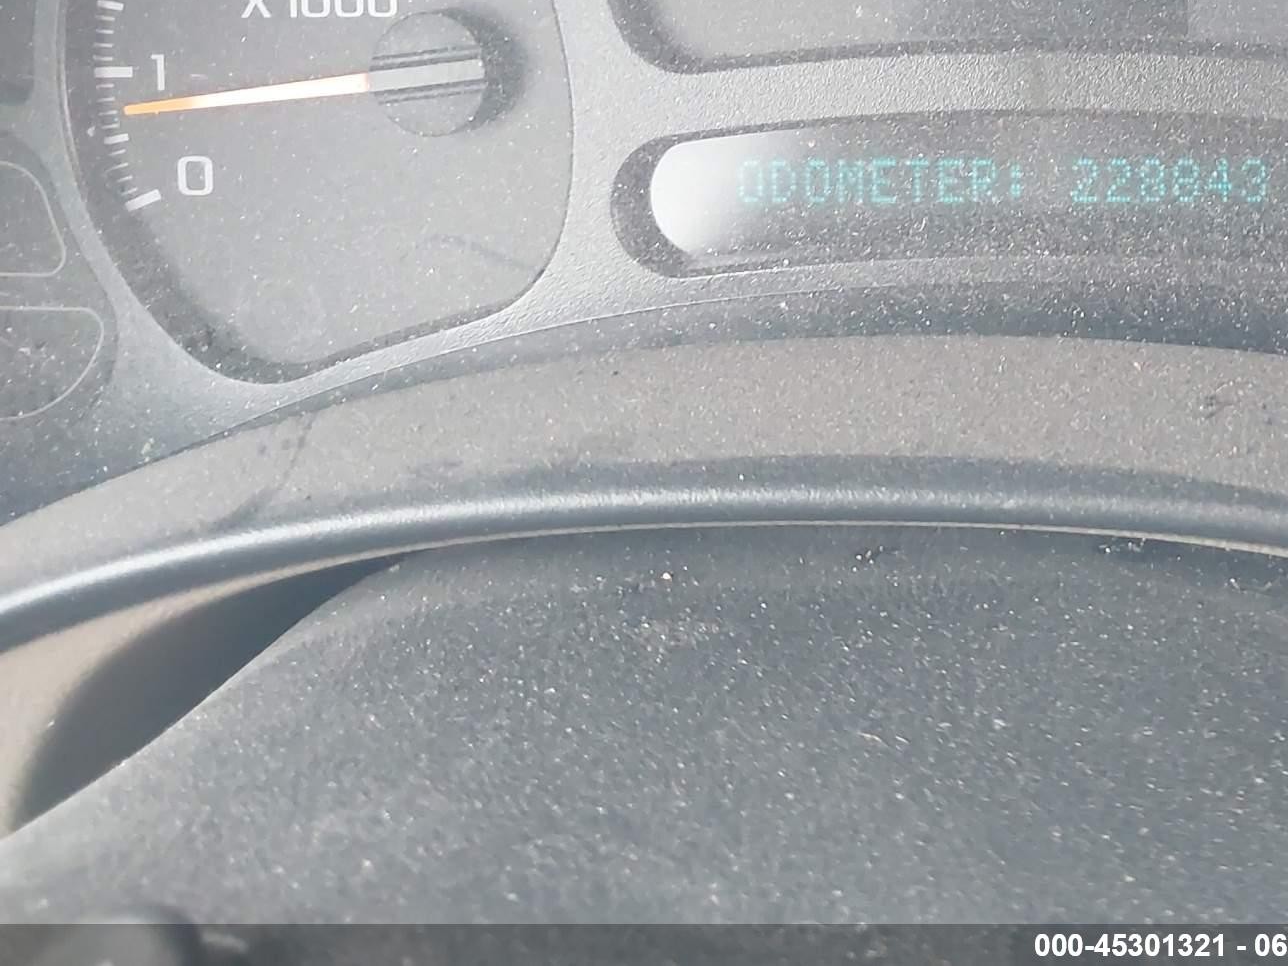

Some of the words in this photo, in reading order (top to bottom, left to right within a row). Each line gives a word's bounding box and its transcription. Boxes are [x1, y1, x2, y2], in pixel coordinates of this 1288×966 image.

[150, 54, 166, 91] 1
[177, 155, 214, 196] 0
[738, 156, 1023, 204] ODOMETER:
[1070, 157, 1267, 203] 228843
